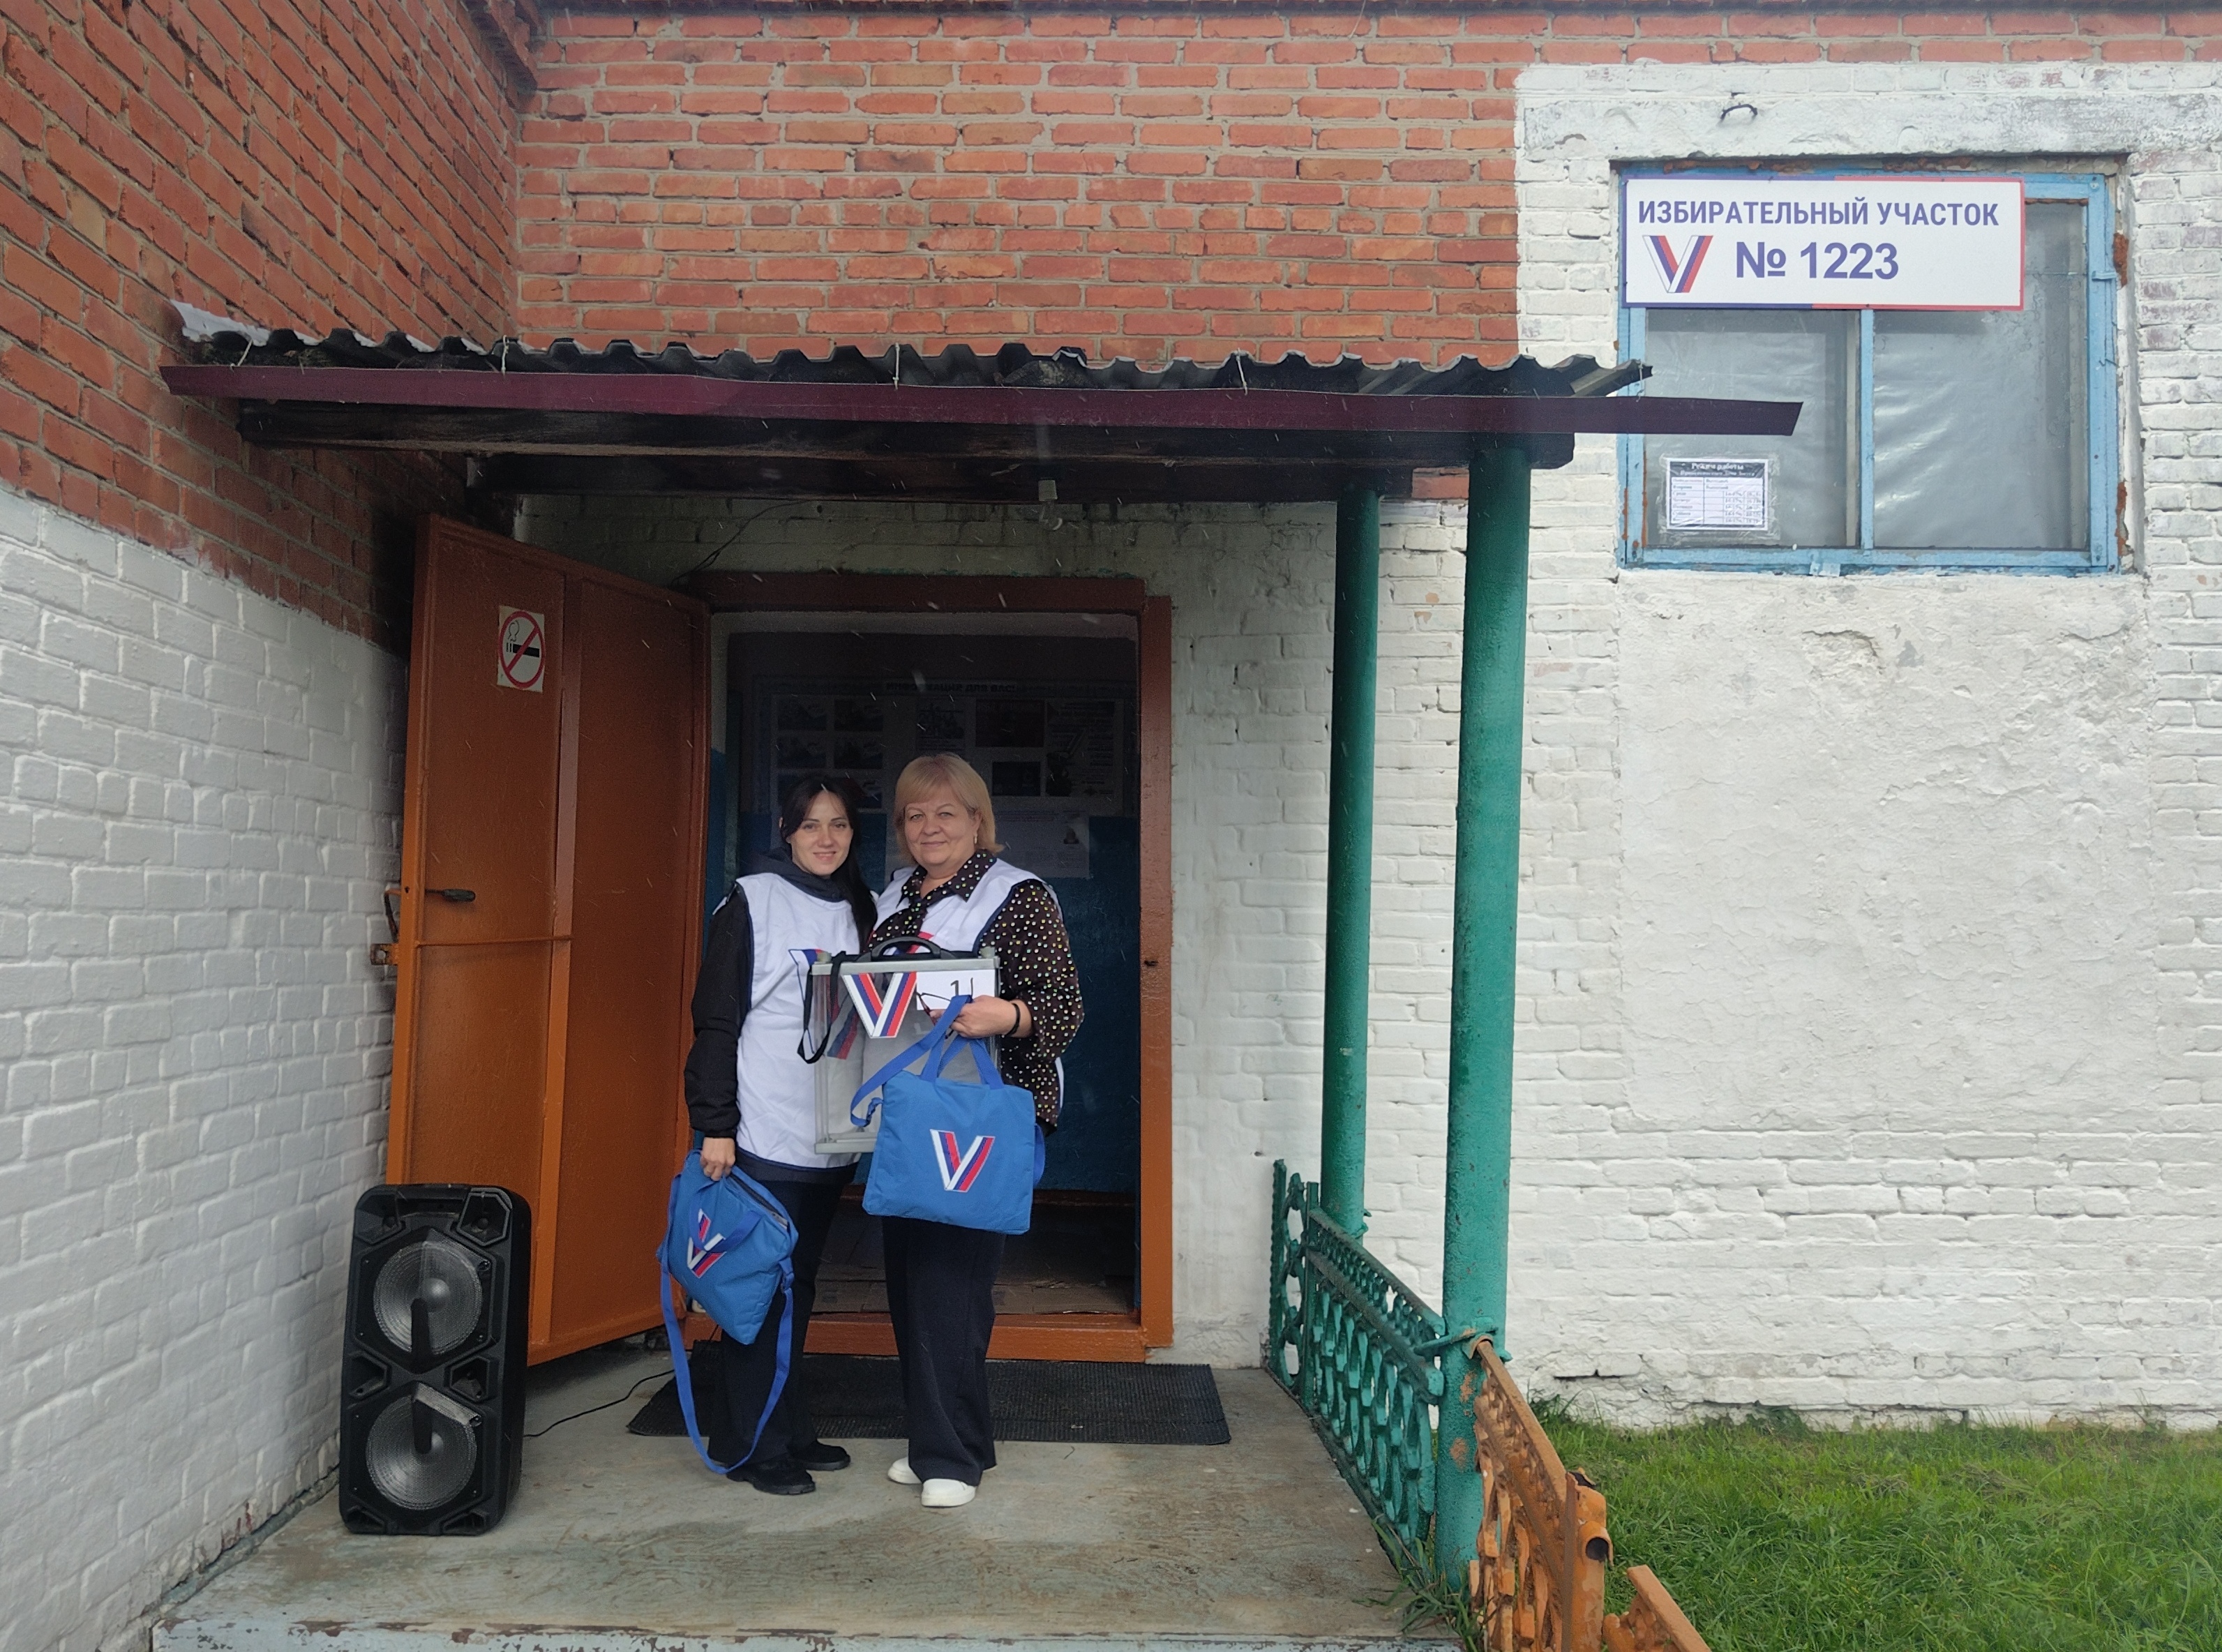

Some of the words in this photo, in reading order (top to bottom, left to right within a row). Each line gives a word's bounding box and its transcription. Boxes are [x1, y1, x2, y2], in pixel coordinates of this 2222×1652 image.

[1638, 197, 1869, 225] ИЗБИРАТЕЛЬНЫЙ
[1877, 202, 1999, 227] УЧАСТОК
[1736, 241, 1787, 278] №
[1800, 242, 1900, 280] 1223
[886, 682, 963, 693] ИНФОМАЦИЯ
